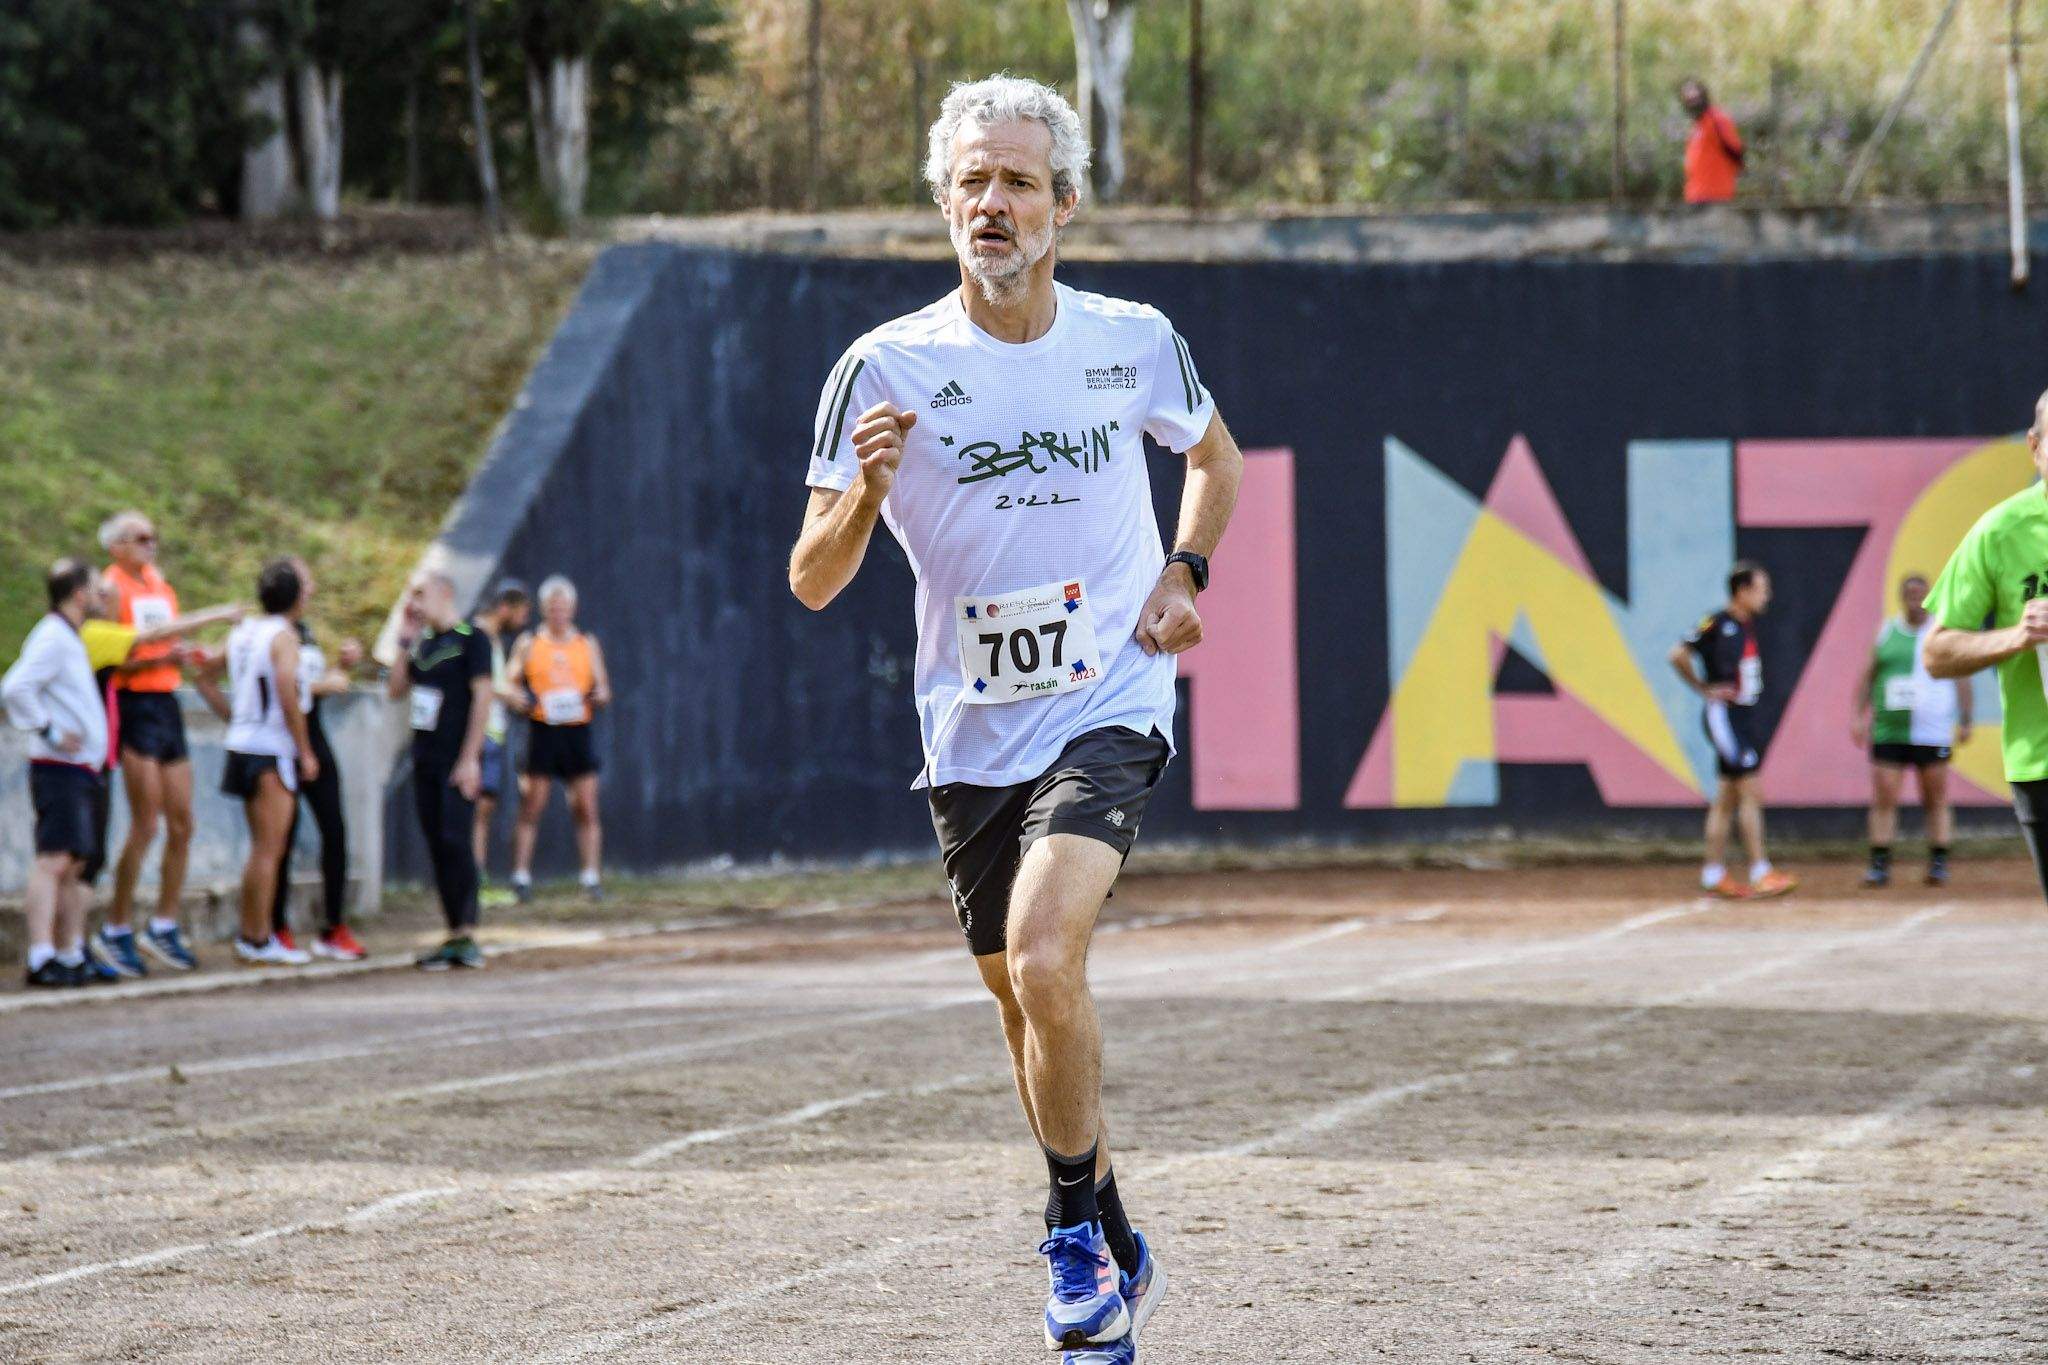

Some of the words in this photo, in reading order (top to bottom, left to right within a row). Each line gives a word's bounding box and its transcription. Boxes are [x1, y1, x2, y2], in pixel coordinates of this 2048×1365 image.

[1085, 368, 1110, 377] BMW
[1124, 366, 1137, 378] 20
[1124, 378, 1137, 389] 22
[930, 394, 973, 409] adidas
[995, 493, 1081, 510] 2022
[978, 619, 1068, 678] 707
[1068, 667, 1097, 682] 2023
